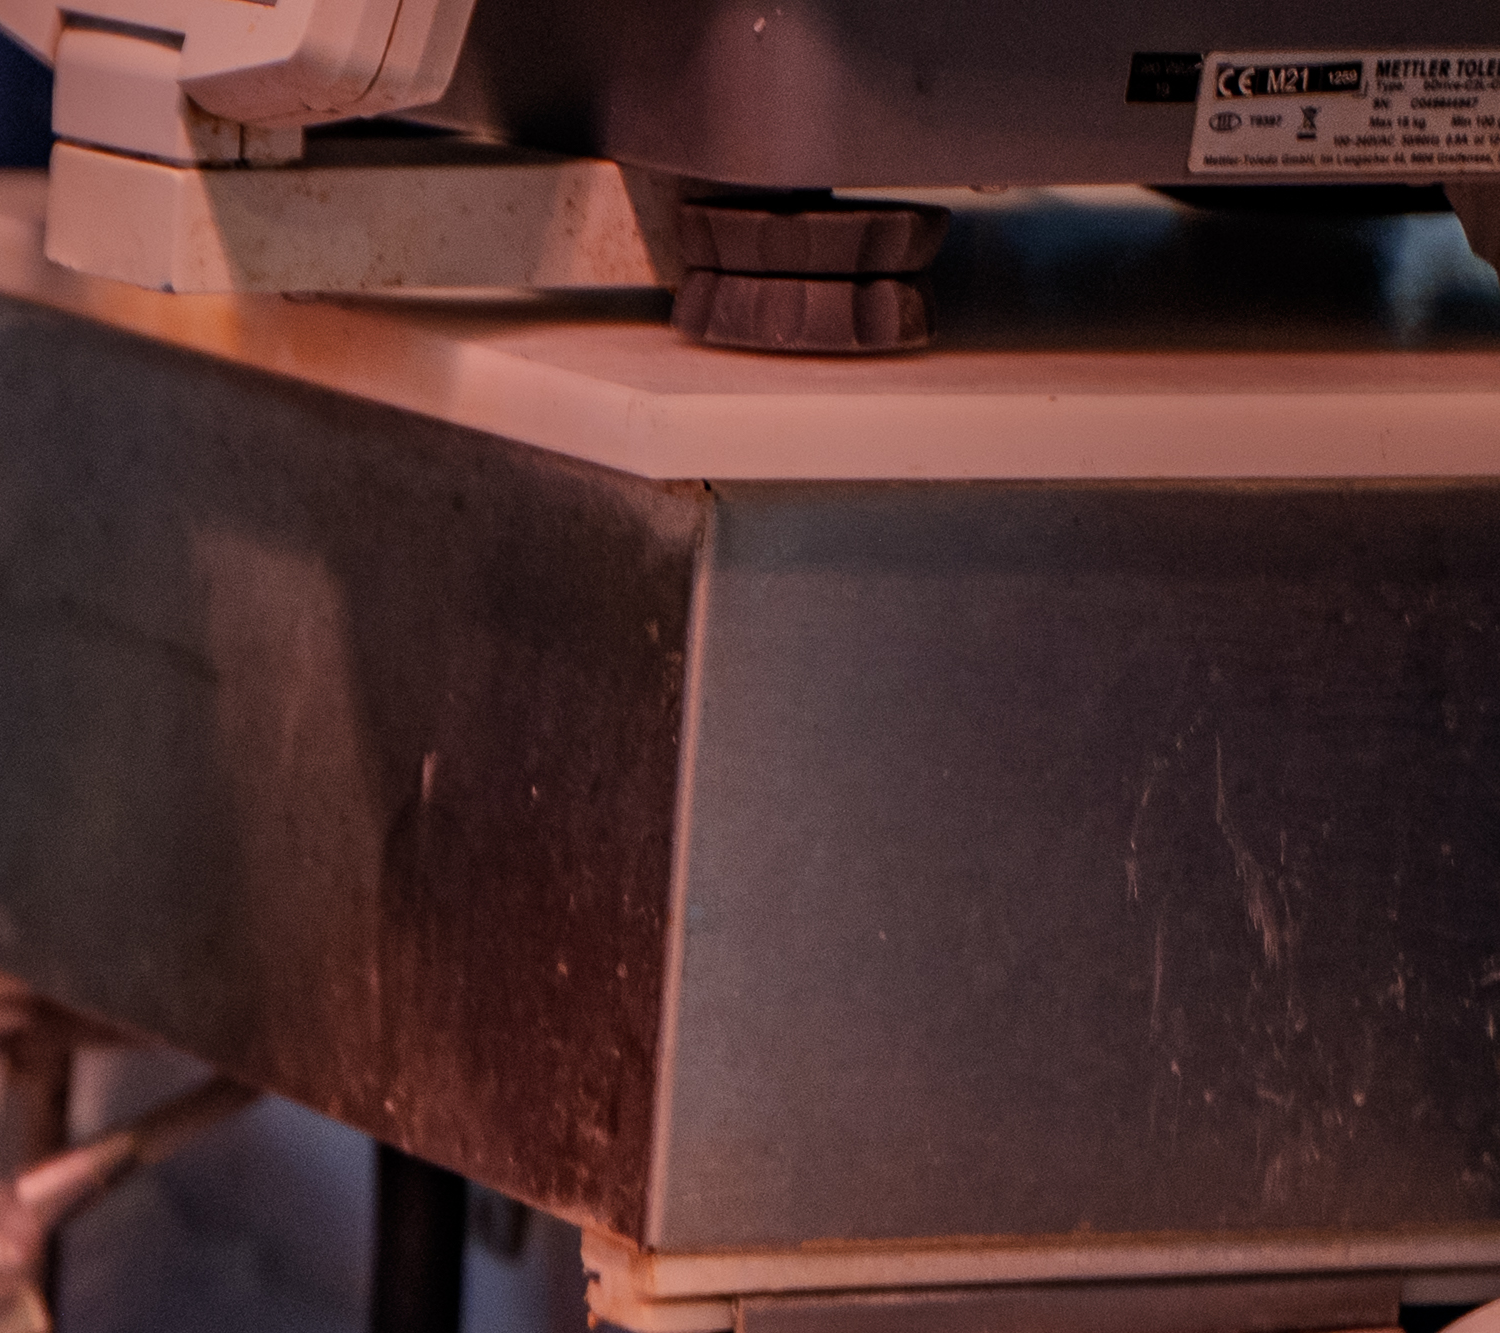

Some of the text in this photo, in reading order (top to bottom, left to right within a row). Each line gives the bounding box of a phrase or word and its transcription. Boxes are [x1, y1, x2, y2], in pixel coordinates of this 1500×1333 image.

[1376, 59, 1500, 78] METTLER TOLE
[1267, 67, 1309, 93] M21
